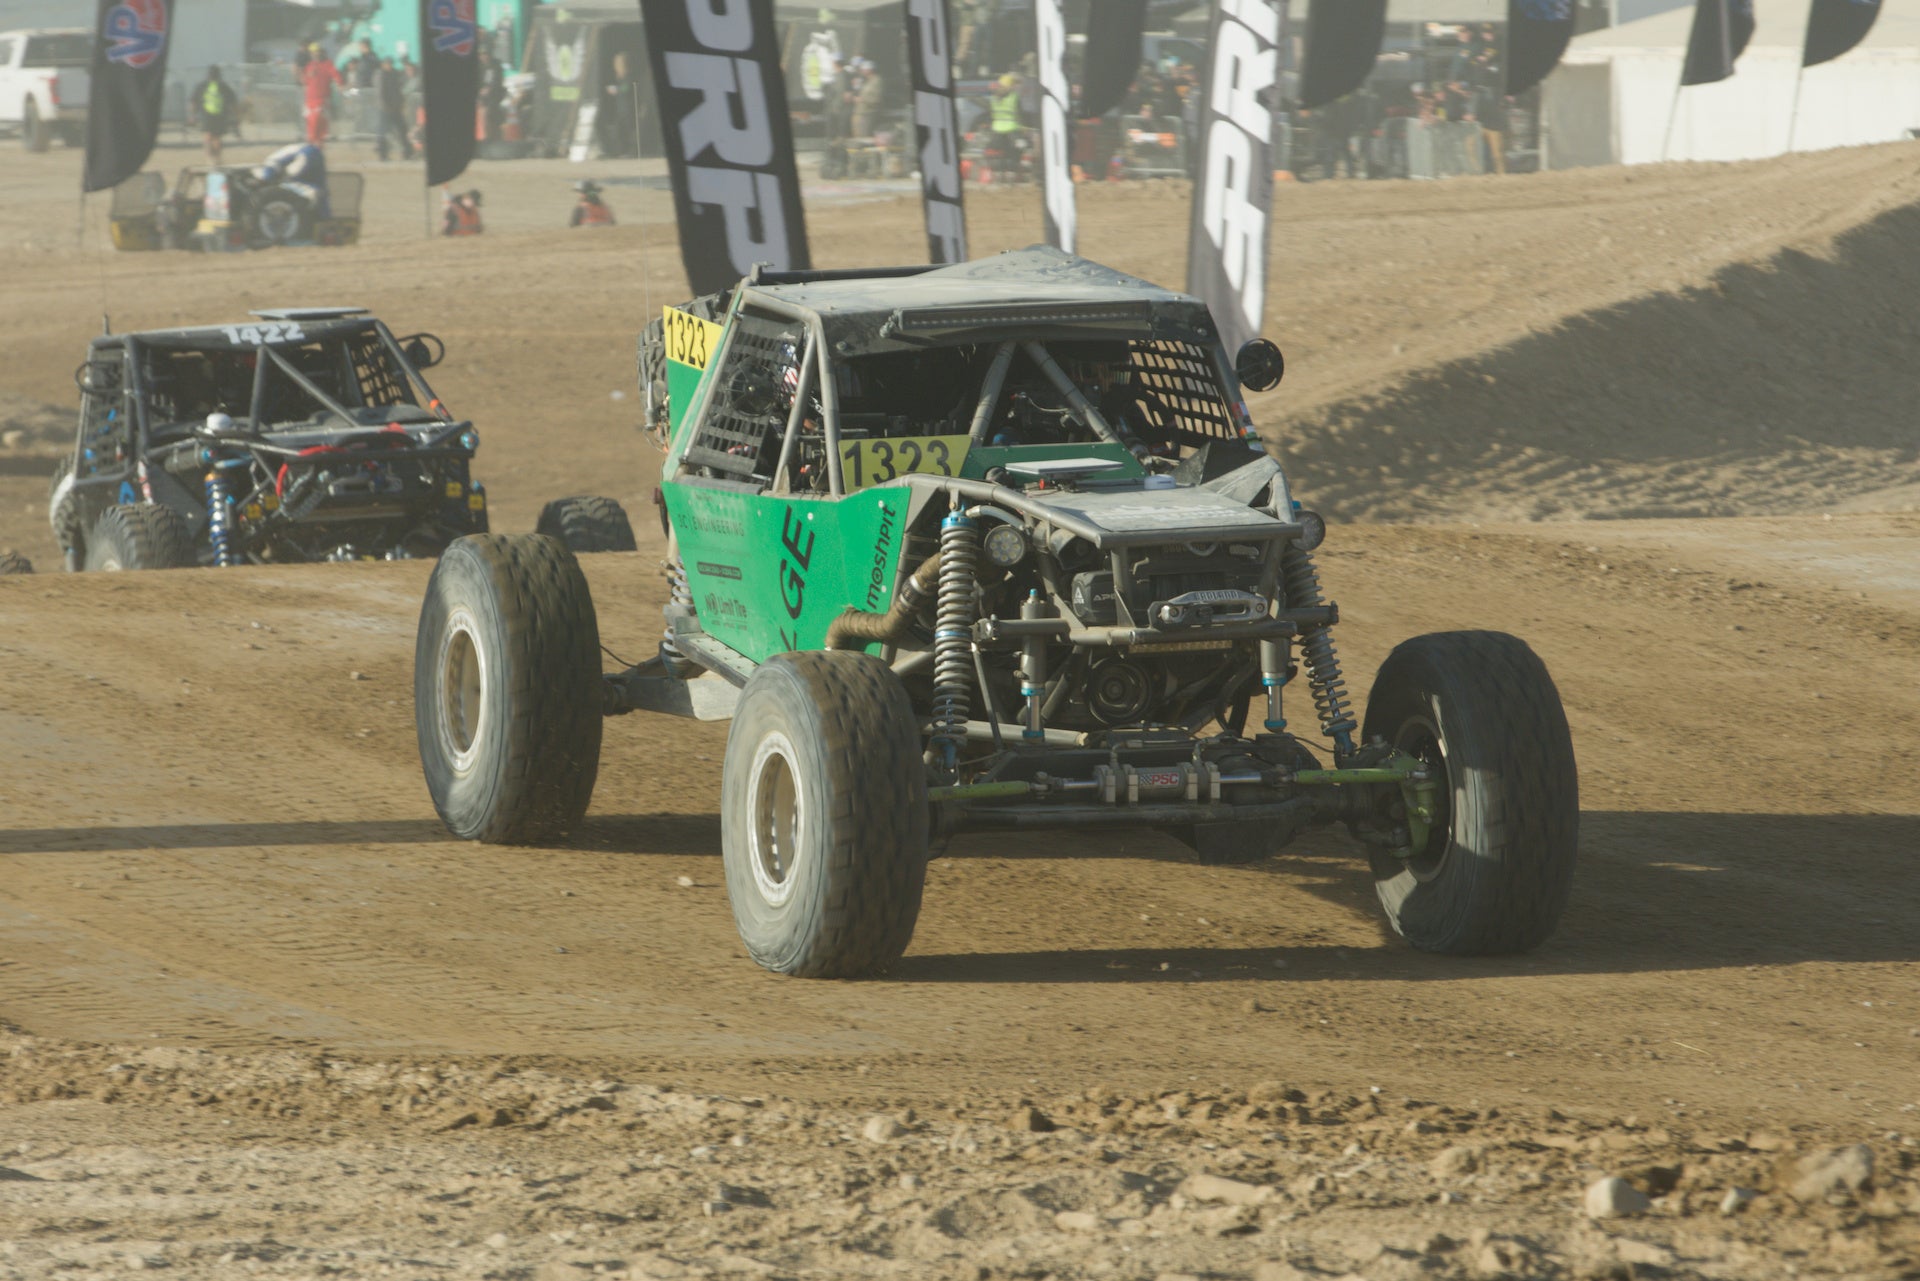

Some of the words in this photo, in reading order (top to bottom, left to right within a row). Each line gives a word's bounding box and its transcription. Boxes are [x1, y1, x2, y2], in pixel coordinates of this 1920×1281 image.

[1203, 0, 1279, 333] PR
[221, 321, 305, 345] 1422
[666, 310, 707, 369] 1323
[844, 440, 952, 487] 1323
[691, 515, 745, 537] ENGINEERING
[733, 599, 748, 619] Tire
[1151, 773, 1179, 785] PSC
